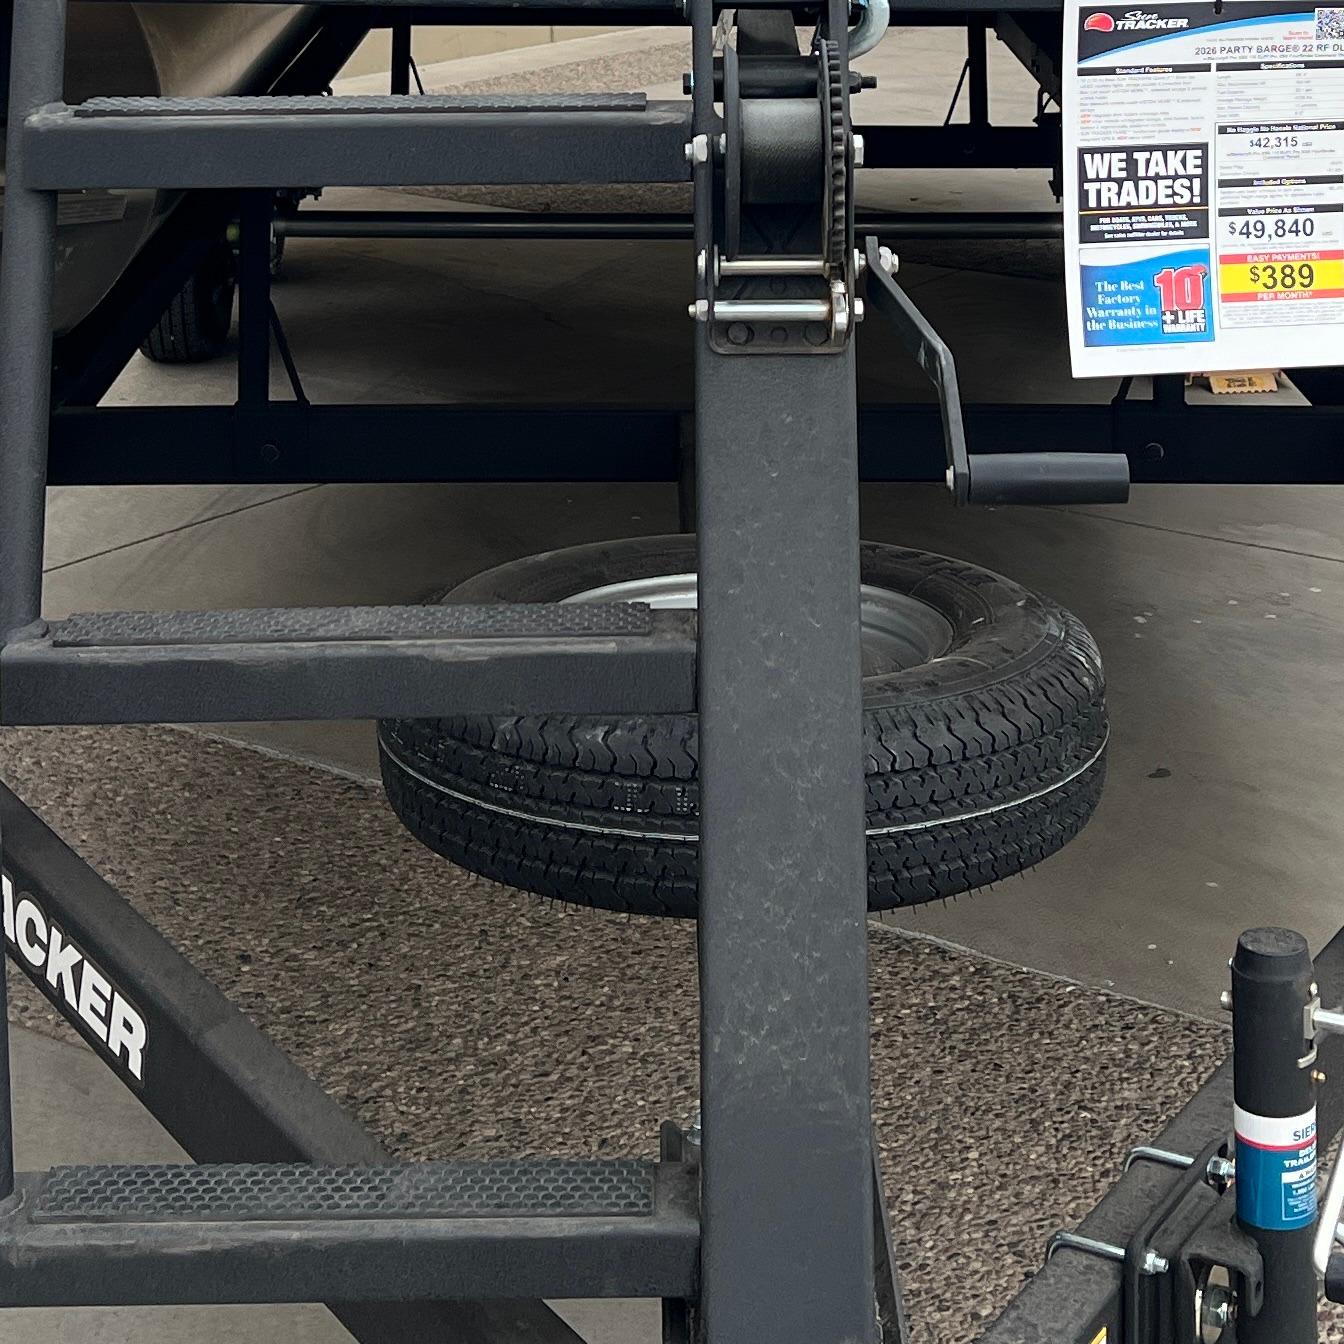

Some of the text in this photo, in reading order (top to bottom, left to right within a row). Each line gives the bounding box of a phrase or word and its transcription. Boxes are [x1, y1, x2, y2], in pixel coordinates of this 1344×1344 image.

[1120, 10, 1158, 21] Sun
[1116, 18, 1189, 30] TRACKER
[1219, 44, 1253, 54] PARTY
[1302, 43, 1313, 53] 22
[1316, 43, 1329, 52] RF
[1249, 136, 1298, 149] $42,315
[1083, 152, 1127, 179] WE
[1133, 149, 1203, 176] TAKE
[1083, 177, 1201, 207] TRADES!
[1228, 217, 1315, 242] $49,840
[1247, 254, 1270, 263] EASY
[1249, 263, 1315, 290] $389
[1095, 280, 1145, 292] The Best
[1097, 294, 1141, 306] Factory
[1257, 292, 1275, 301] PER
[1086, 304, 1157, 319] Warranty in
[1177, 310, 1206, 324] LIFE
[1086, 317, 1159, 332] the Business
[1, 873, 148, 1081] CKER
